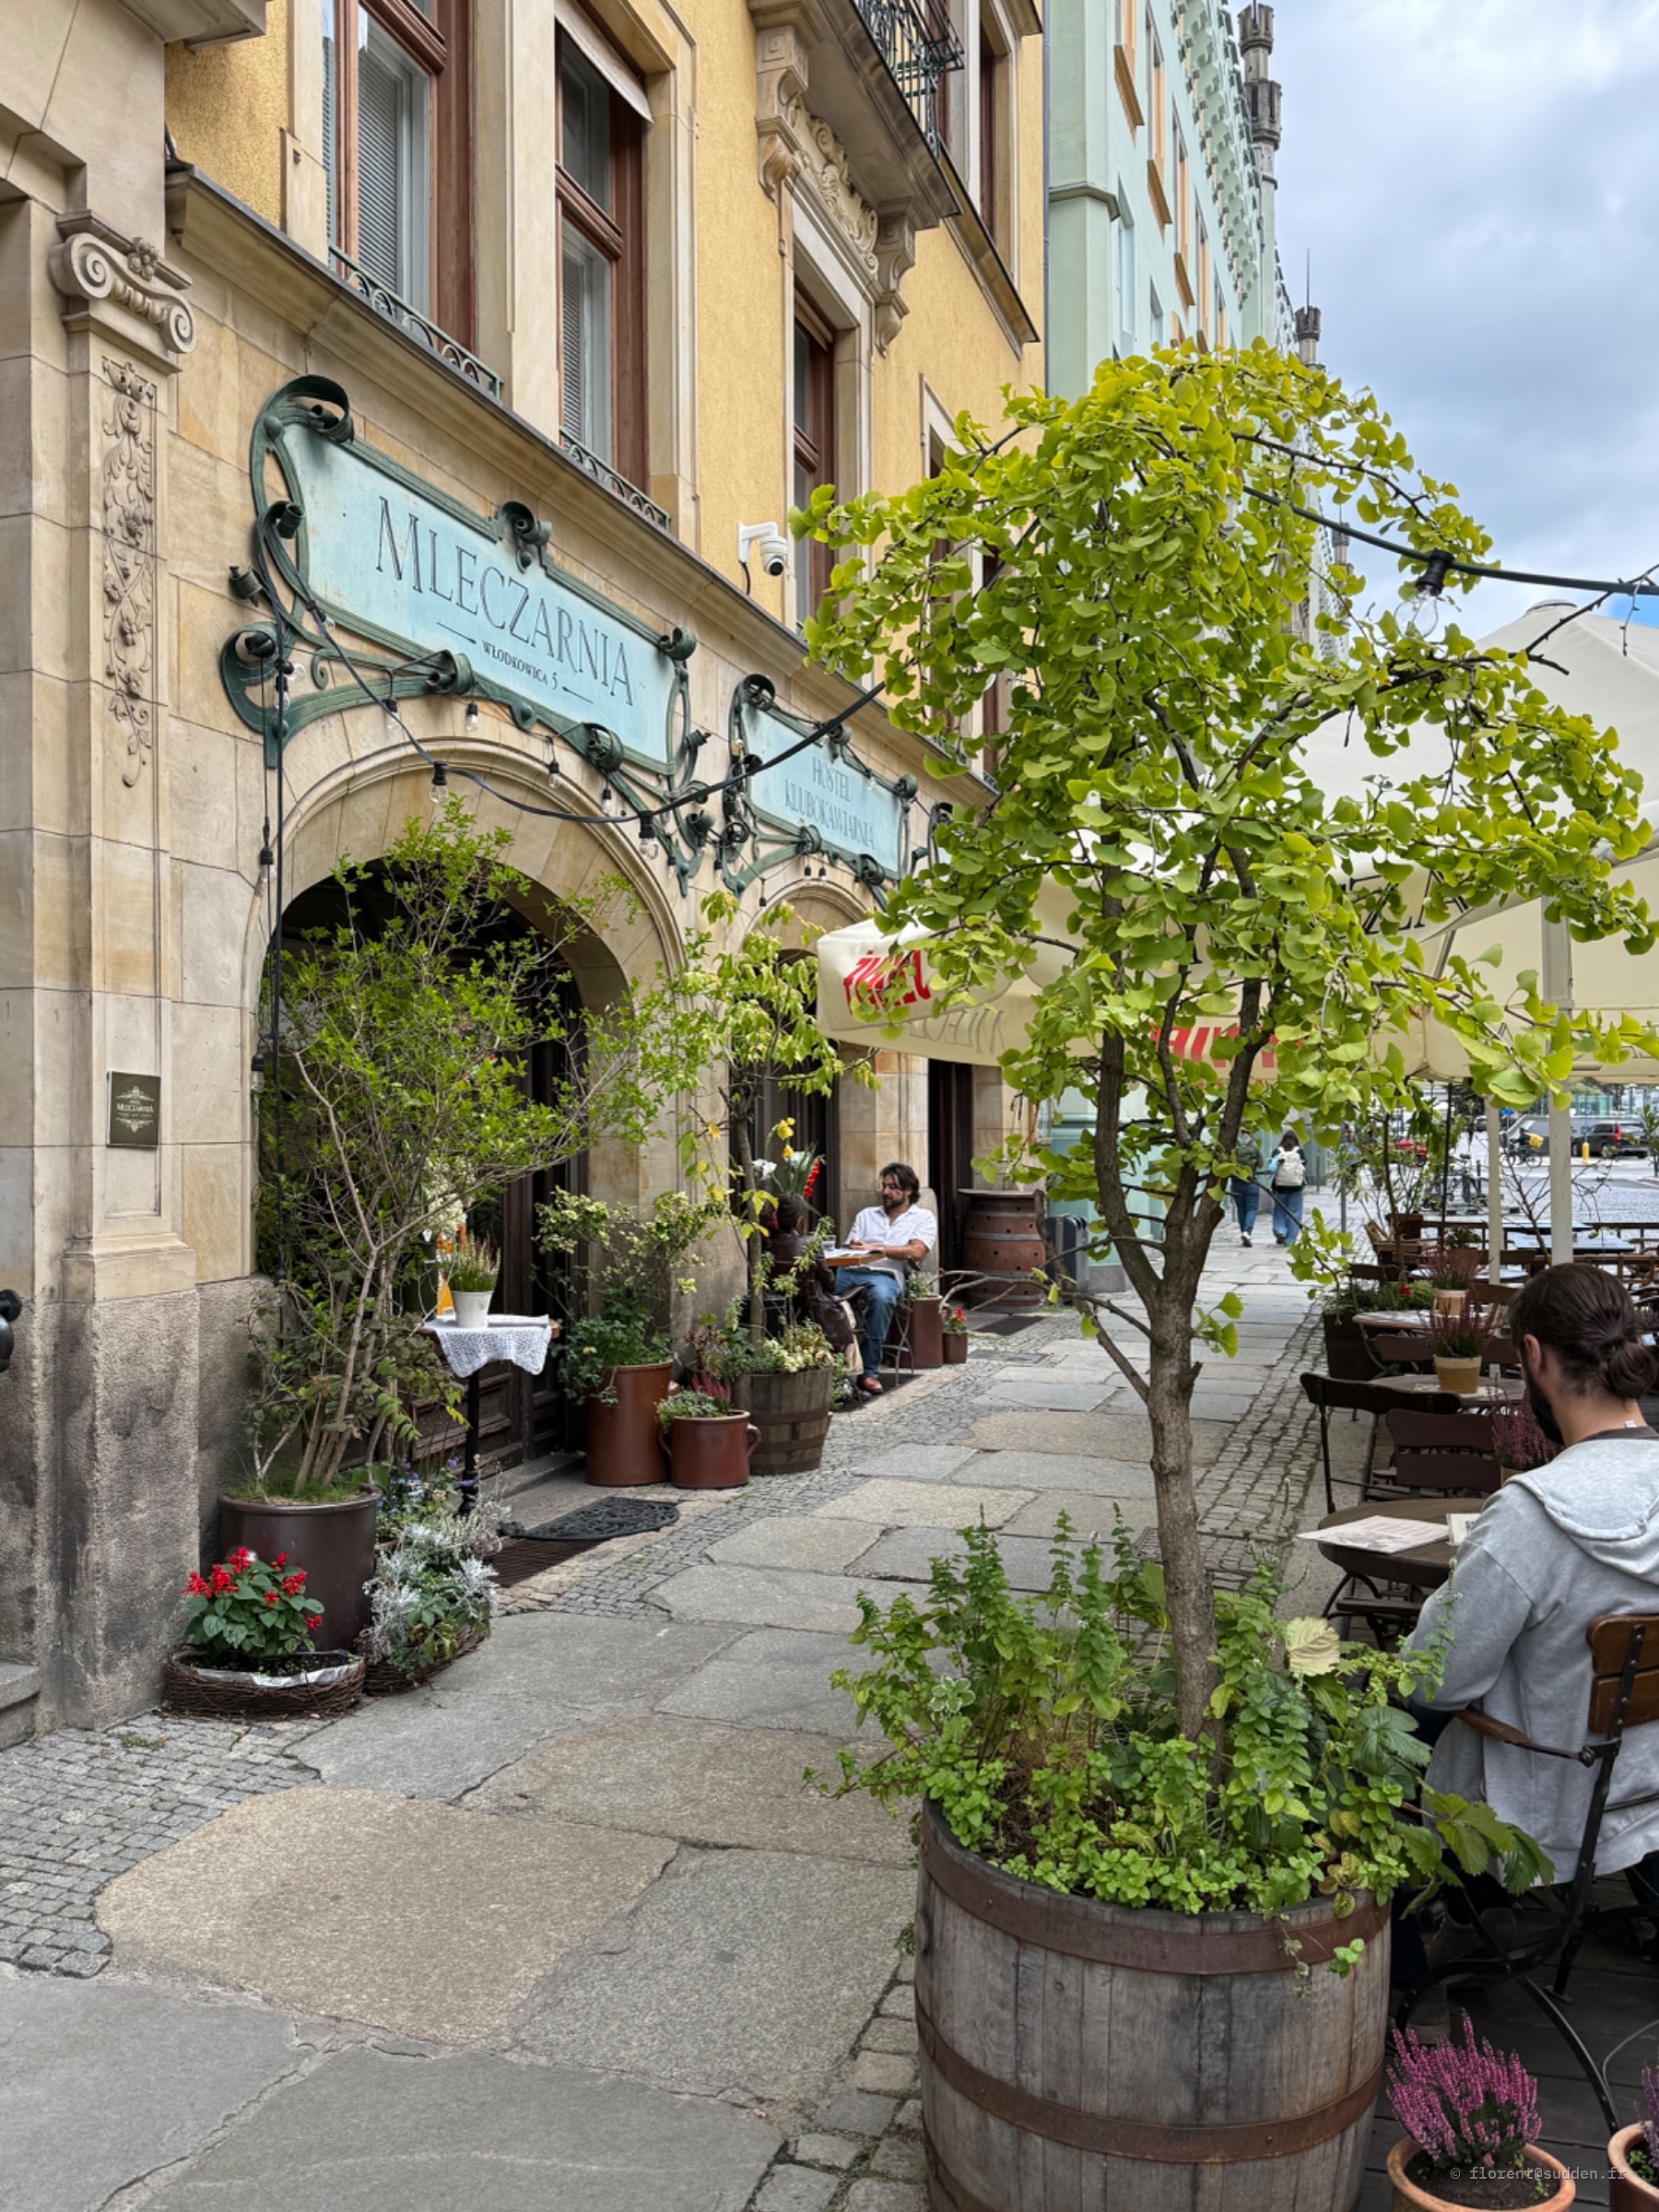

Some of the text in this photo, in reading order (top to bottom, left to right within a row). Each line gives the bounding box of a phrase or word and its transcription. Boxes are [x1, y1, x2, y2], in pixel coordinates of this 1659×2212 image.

[375, 495, 633, 706] MLECZARNIA
[551, 672, 559, 690] 5
[812, 756, 852, 802] HOSTEL
